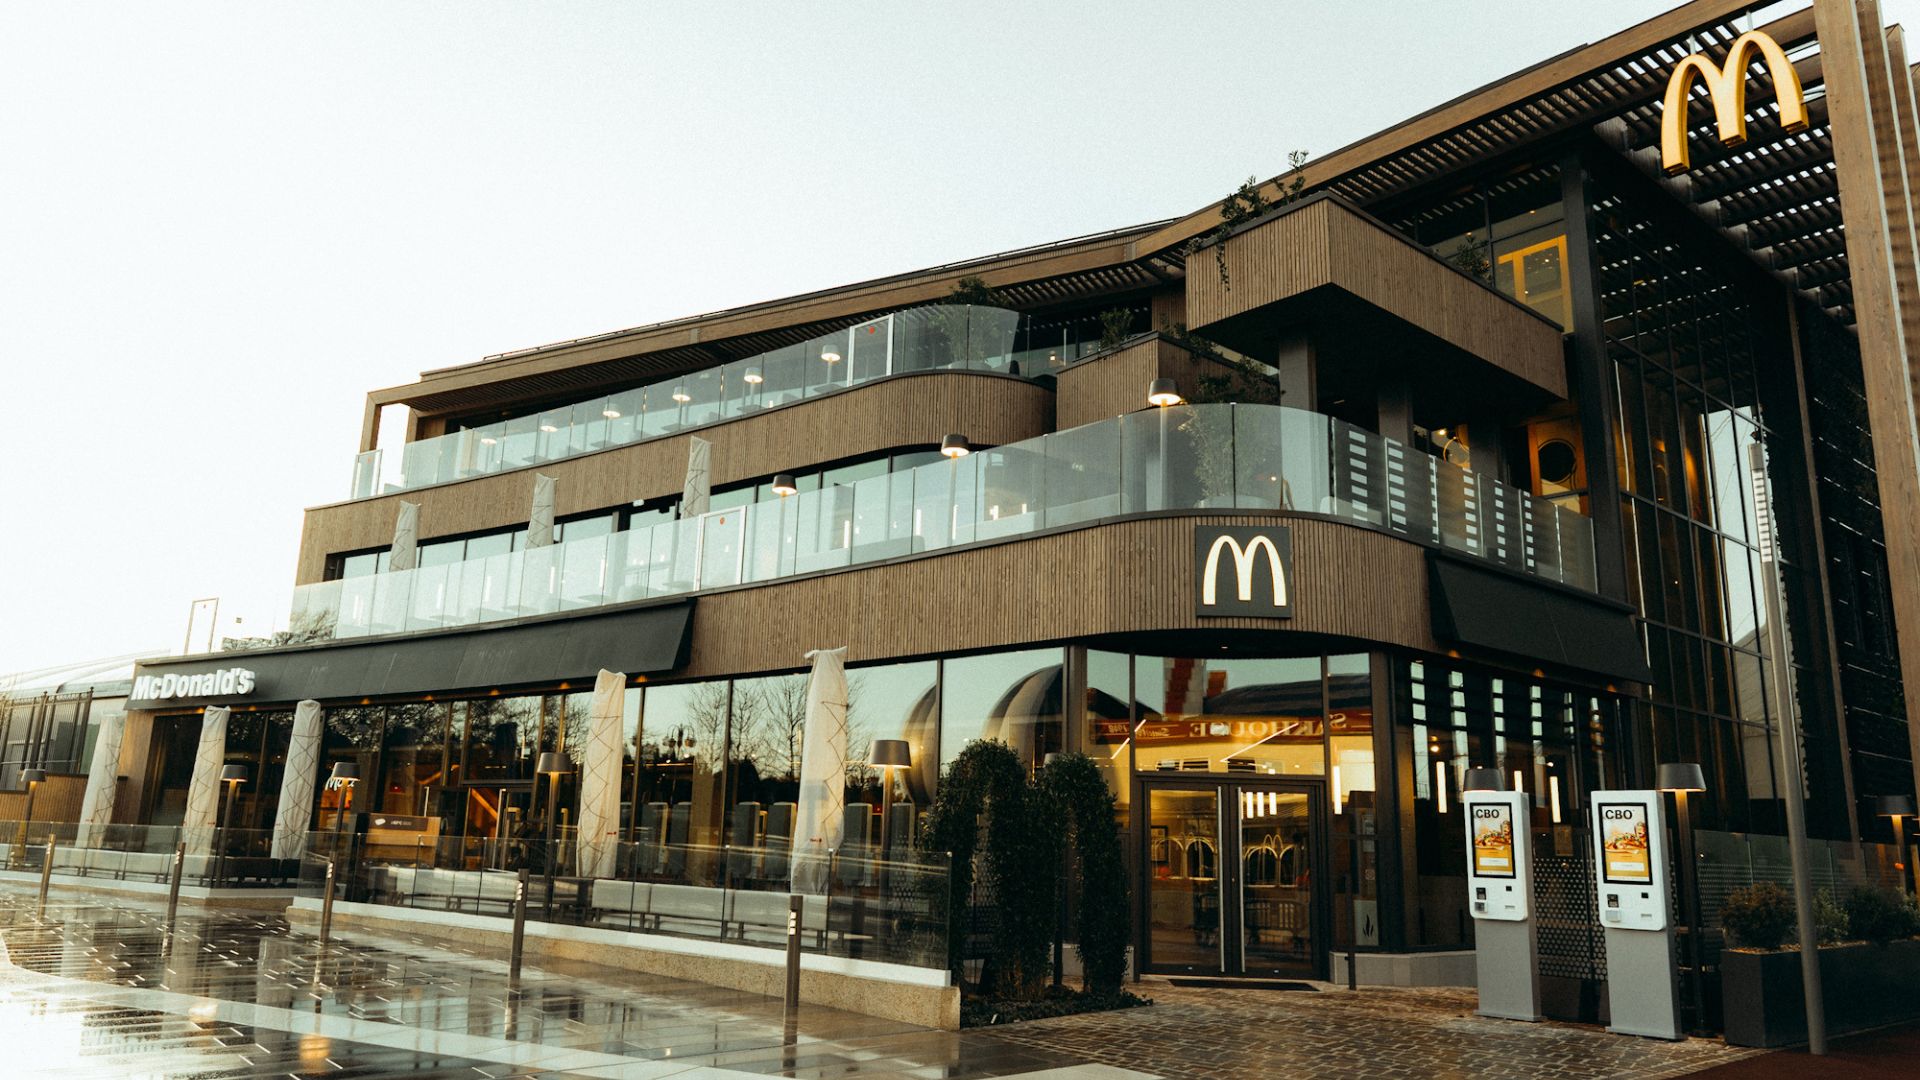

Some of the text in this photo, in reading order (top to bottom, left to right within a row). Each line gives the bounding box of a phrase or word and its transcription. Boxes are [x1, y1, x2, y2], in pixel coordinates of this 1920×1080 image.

[131, 667, 255, 700] McDonald's
[1475, 808, 1500, 819] CBO
[1605, 809, 1633, 820] CBO
